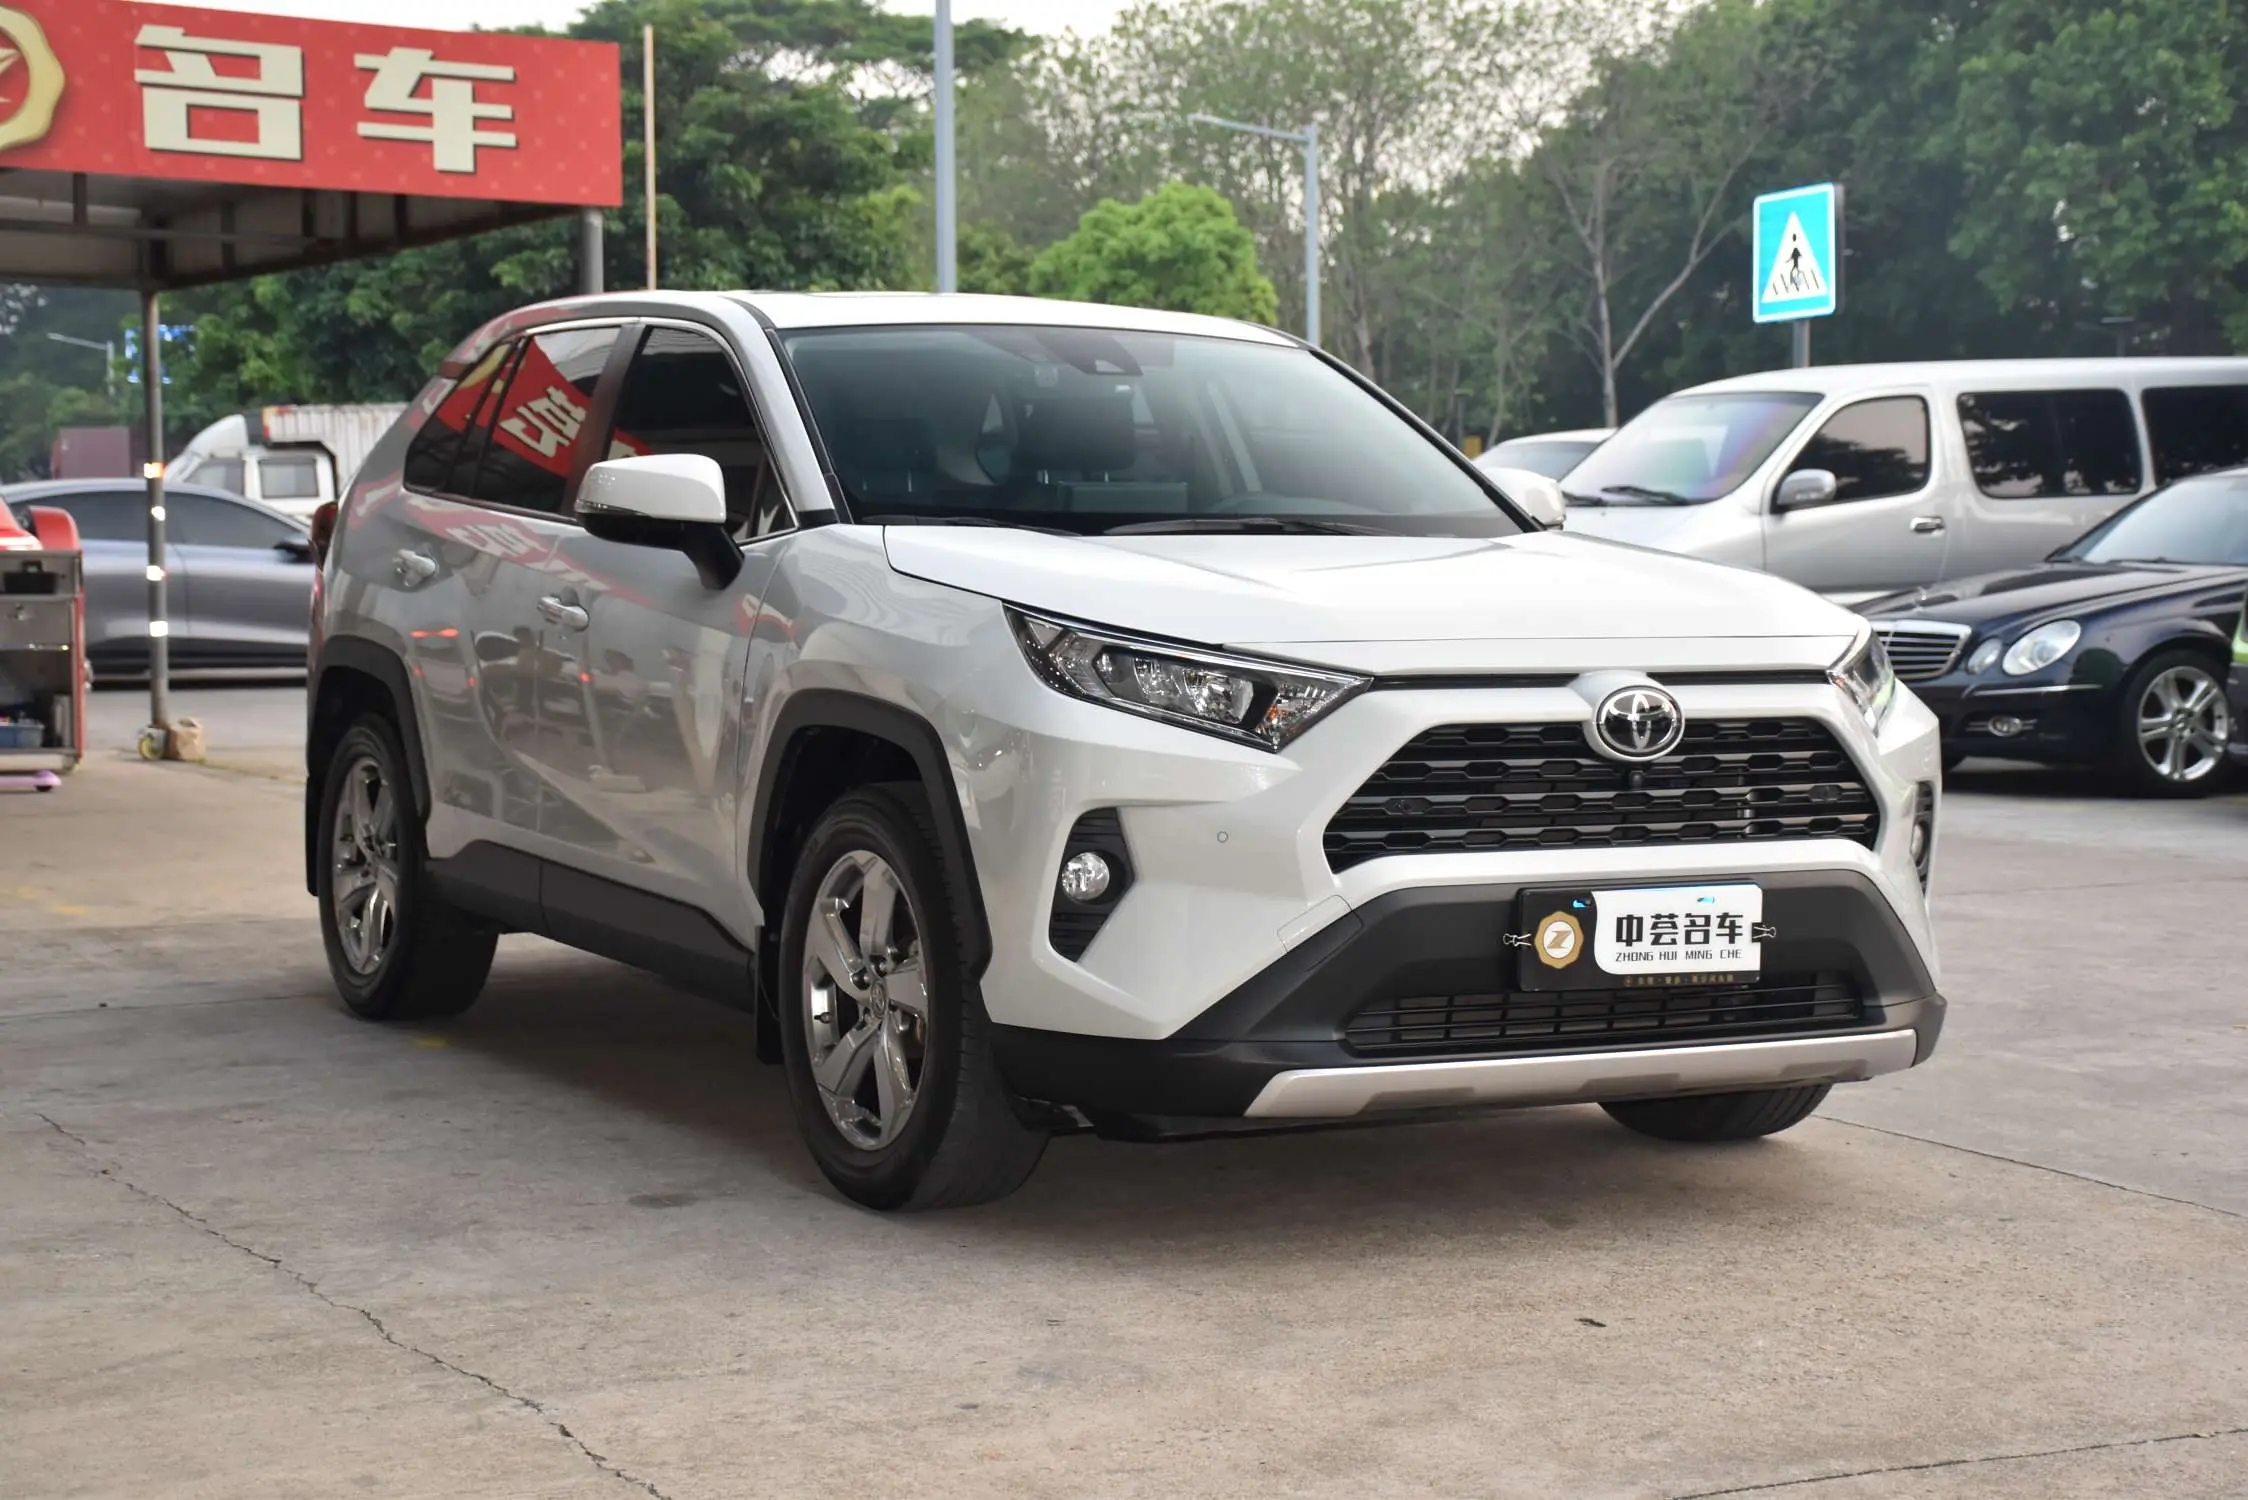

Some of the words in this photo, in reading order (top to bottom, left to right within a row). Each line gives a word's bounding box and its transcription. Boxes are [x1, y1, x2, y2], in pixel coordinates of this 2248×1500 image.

[134, 24, 517, 173] 名车
[1615, 912, 1744, 947] 中荟名车
[1615, 951, 1654, 962] ZHONG
[1658, 950, 1678, 961] HUI
[1685, 949, 1713, 960] MING
[1719, 948, 1743, 959] CHE
